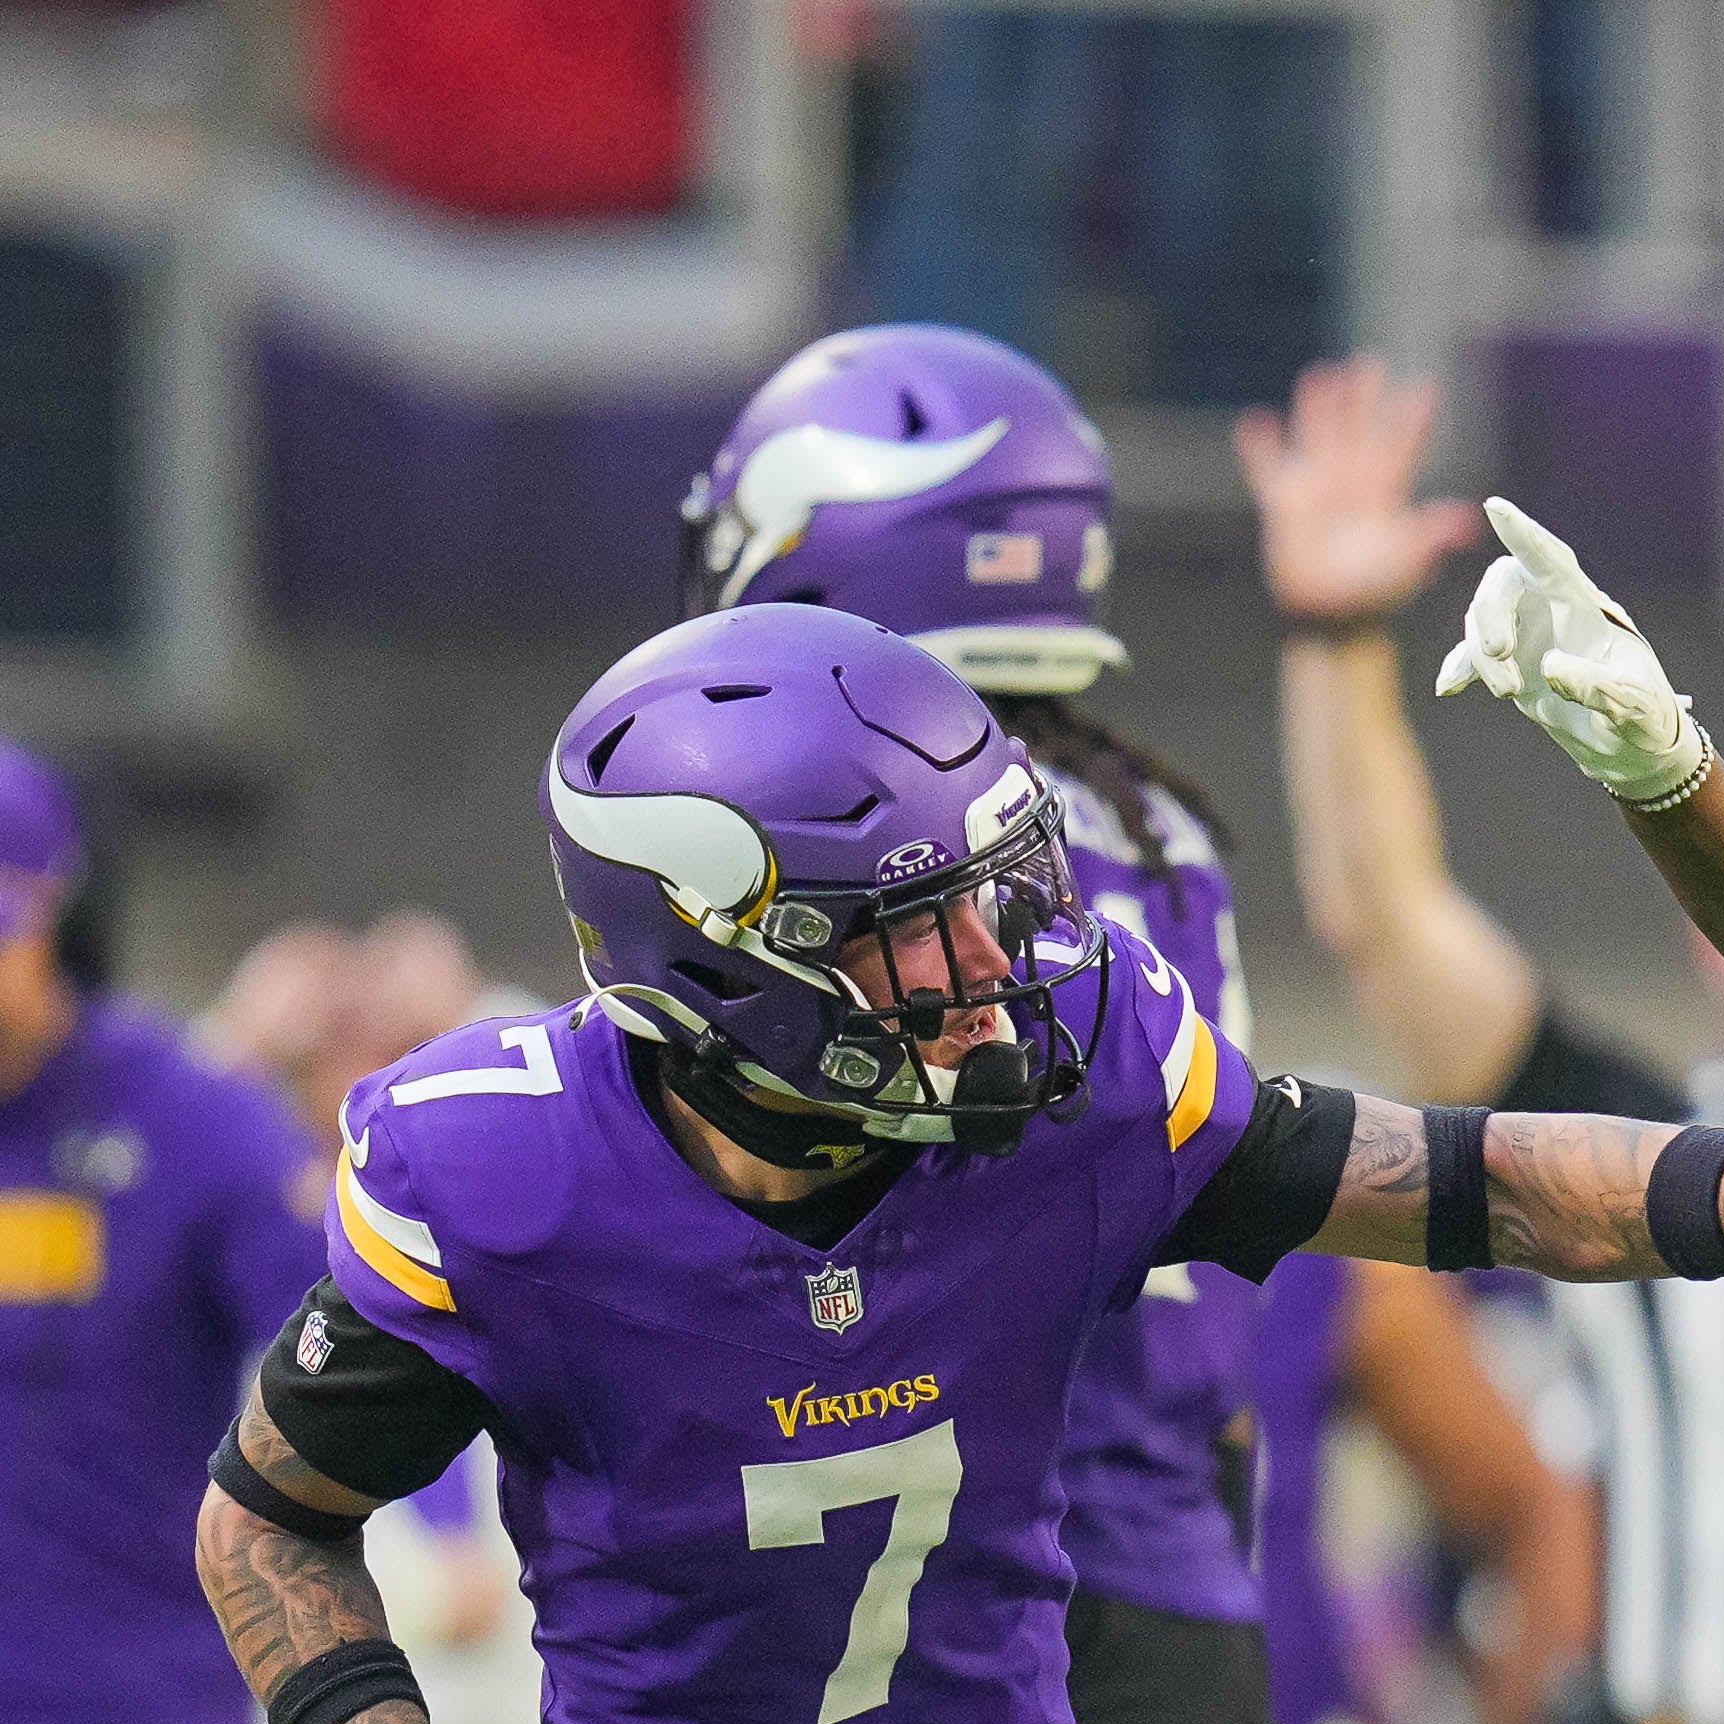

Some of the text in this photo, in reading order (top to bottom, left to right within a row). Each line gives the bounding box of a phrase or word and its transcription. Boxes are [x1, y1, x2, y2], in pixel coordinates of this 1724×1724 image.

[881, 852, 949, 882] OAKLEY
[388, 1024, 565, 1107] 7
[817, 1294, 855, 1321] NFL
[766, 1373, 940, 1438] VIKINGS
